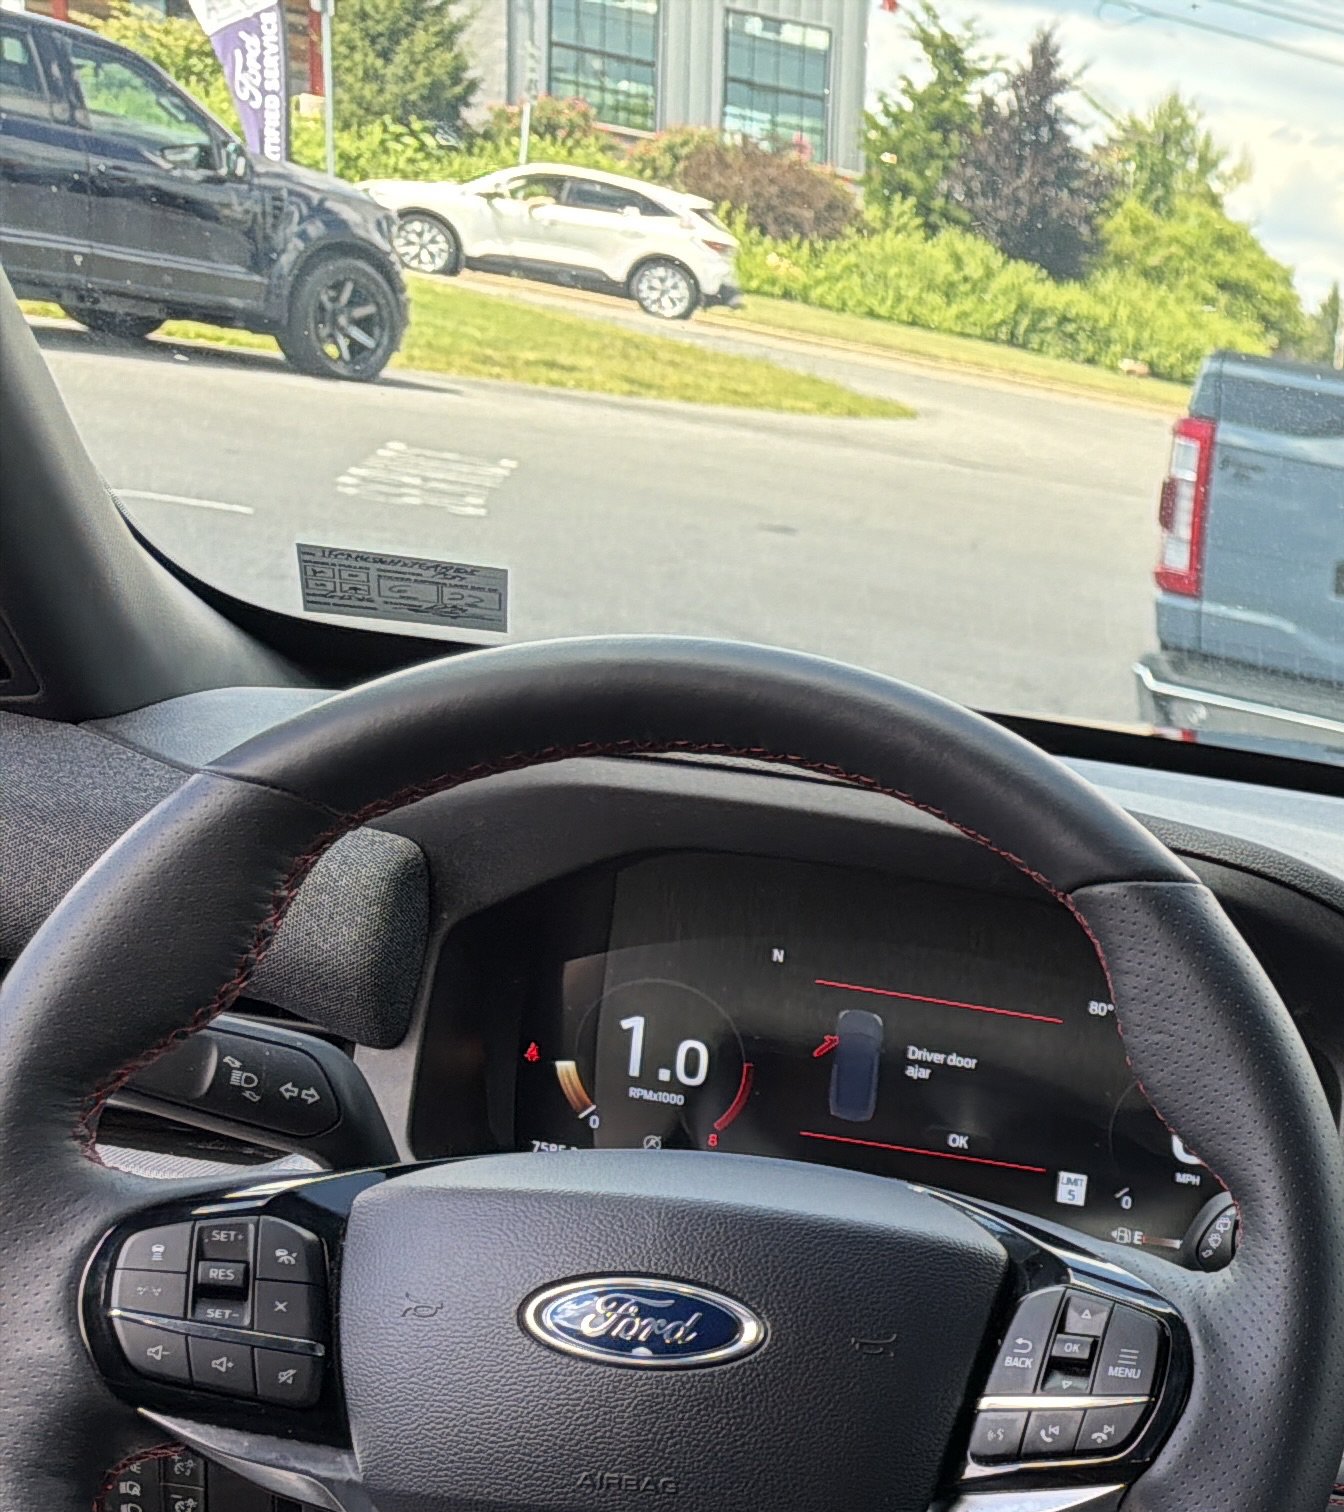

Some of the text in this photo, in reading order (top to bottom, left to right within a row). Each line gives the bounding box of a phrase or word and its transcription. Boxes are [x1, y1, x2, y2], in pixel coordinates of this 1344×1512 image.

[772, 949, 785, 962] N
[620, 1015, 709, 1086] 1.0
[907, 1045, 978, 1070] Driver door
[905, 1064, 932, 1081] ajar
[629, 1087, 685, 1106] RPMx1000
[589, 1115, 600, 1129] 0
[708, 1133, 719, 1147] 8
[947, 1133, 969, 1149] OK
[1175, 1171, 1201, 1186] MPH
[1067, 1190, 1076, 1202] 5
[1120, 1196, 1132, 1209] 0
[1133, 1231, 1143, 1244] E
[209, 1268, 235, 1281] RES
[580, 1292, 702, 1345] Ford
[1064, 1343, 1080, 1354] OK
[1004, 1356, 1033, 1369] BACK
[1108, 1365, 1141, 1379] MENU
[577, 1472, 680, 1494] AIRBAG
